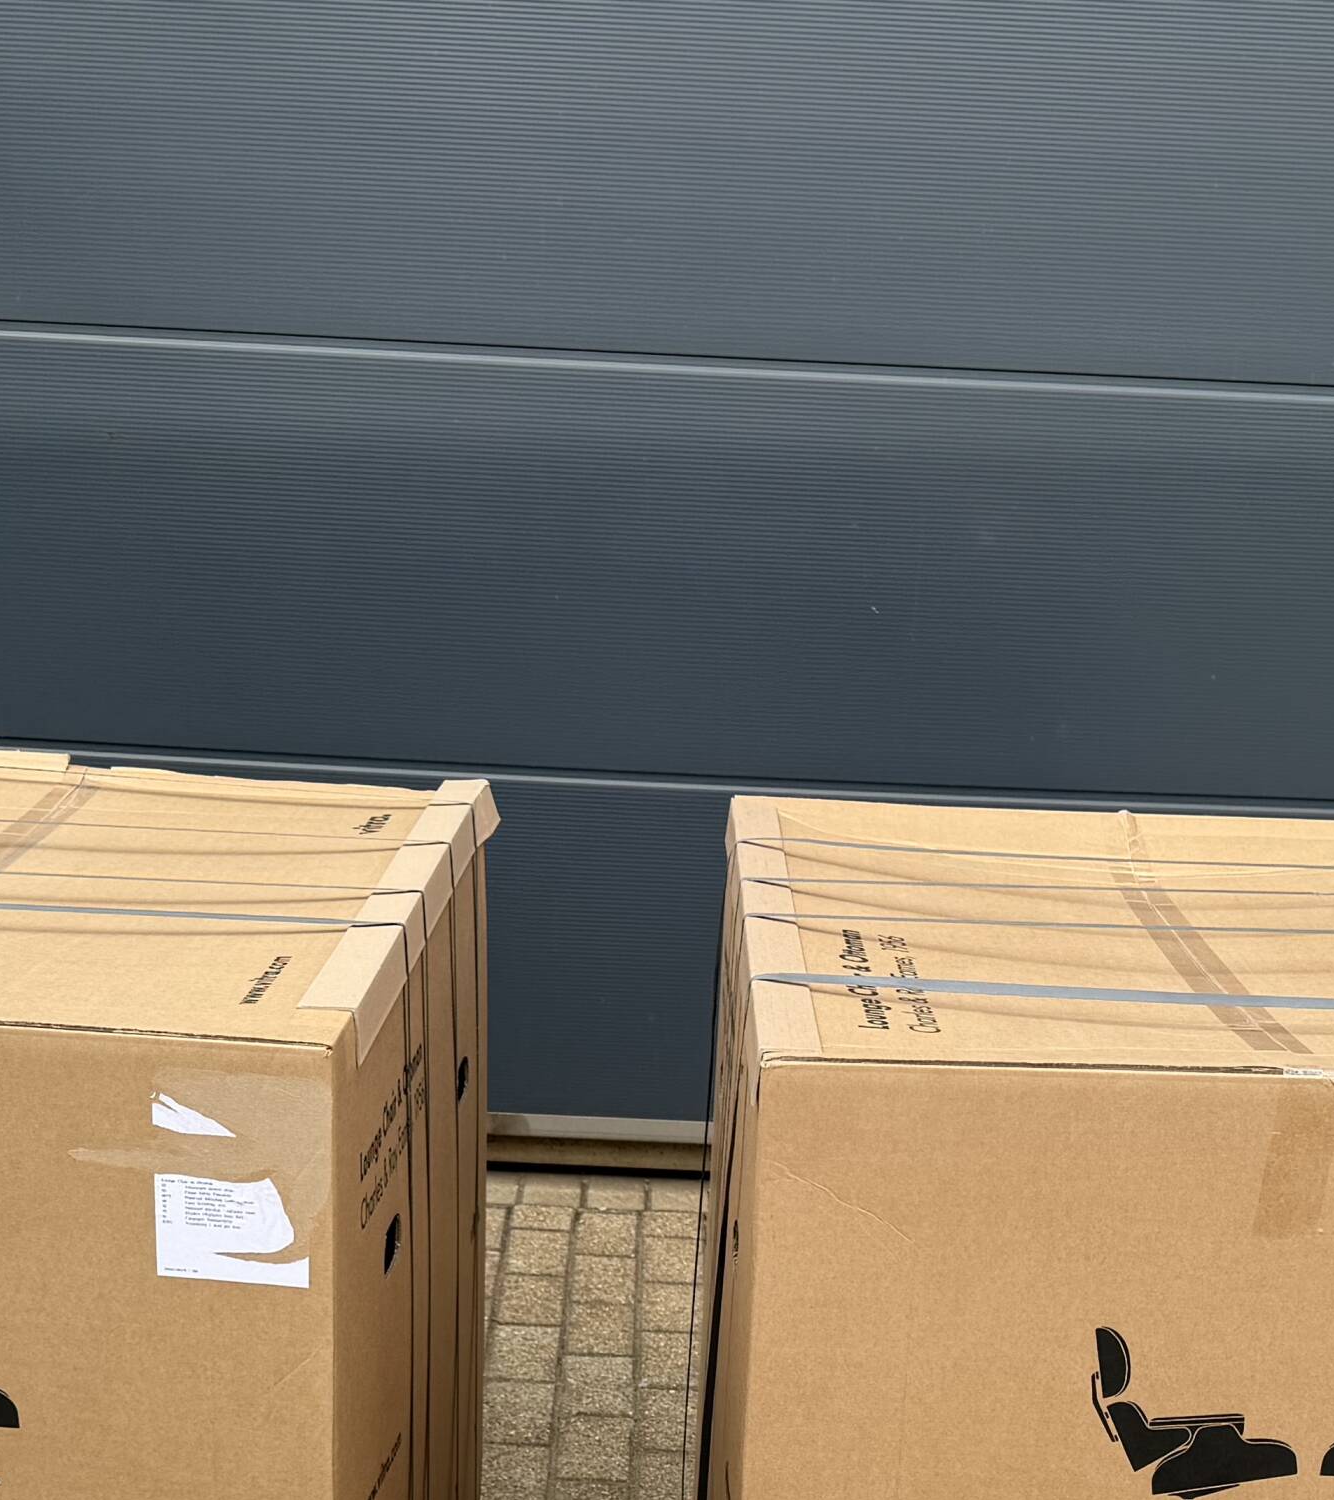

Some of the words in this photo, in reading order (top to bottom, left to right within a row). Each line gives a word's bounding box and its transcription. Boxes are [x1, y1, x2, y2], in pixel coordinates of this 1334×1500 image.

[838, 929, 869, 963] Ottoman
[877, 934, 910, 953] 1956
[238, 955, 293, 1005] www.vitra.com
[842, 964, 872, 973] &
[857, 998, 892, 1030] Lounge
[898, 996, 929, 1004] &
[900, 1005, 942, 1034] Charles
